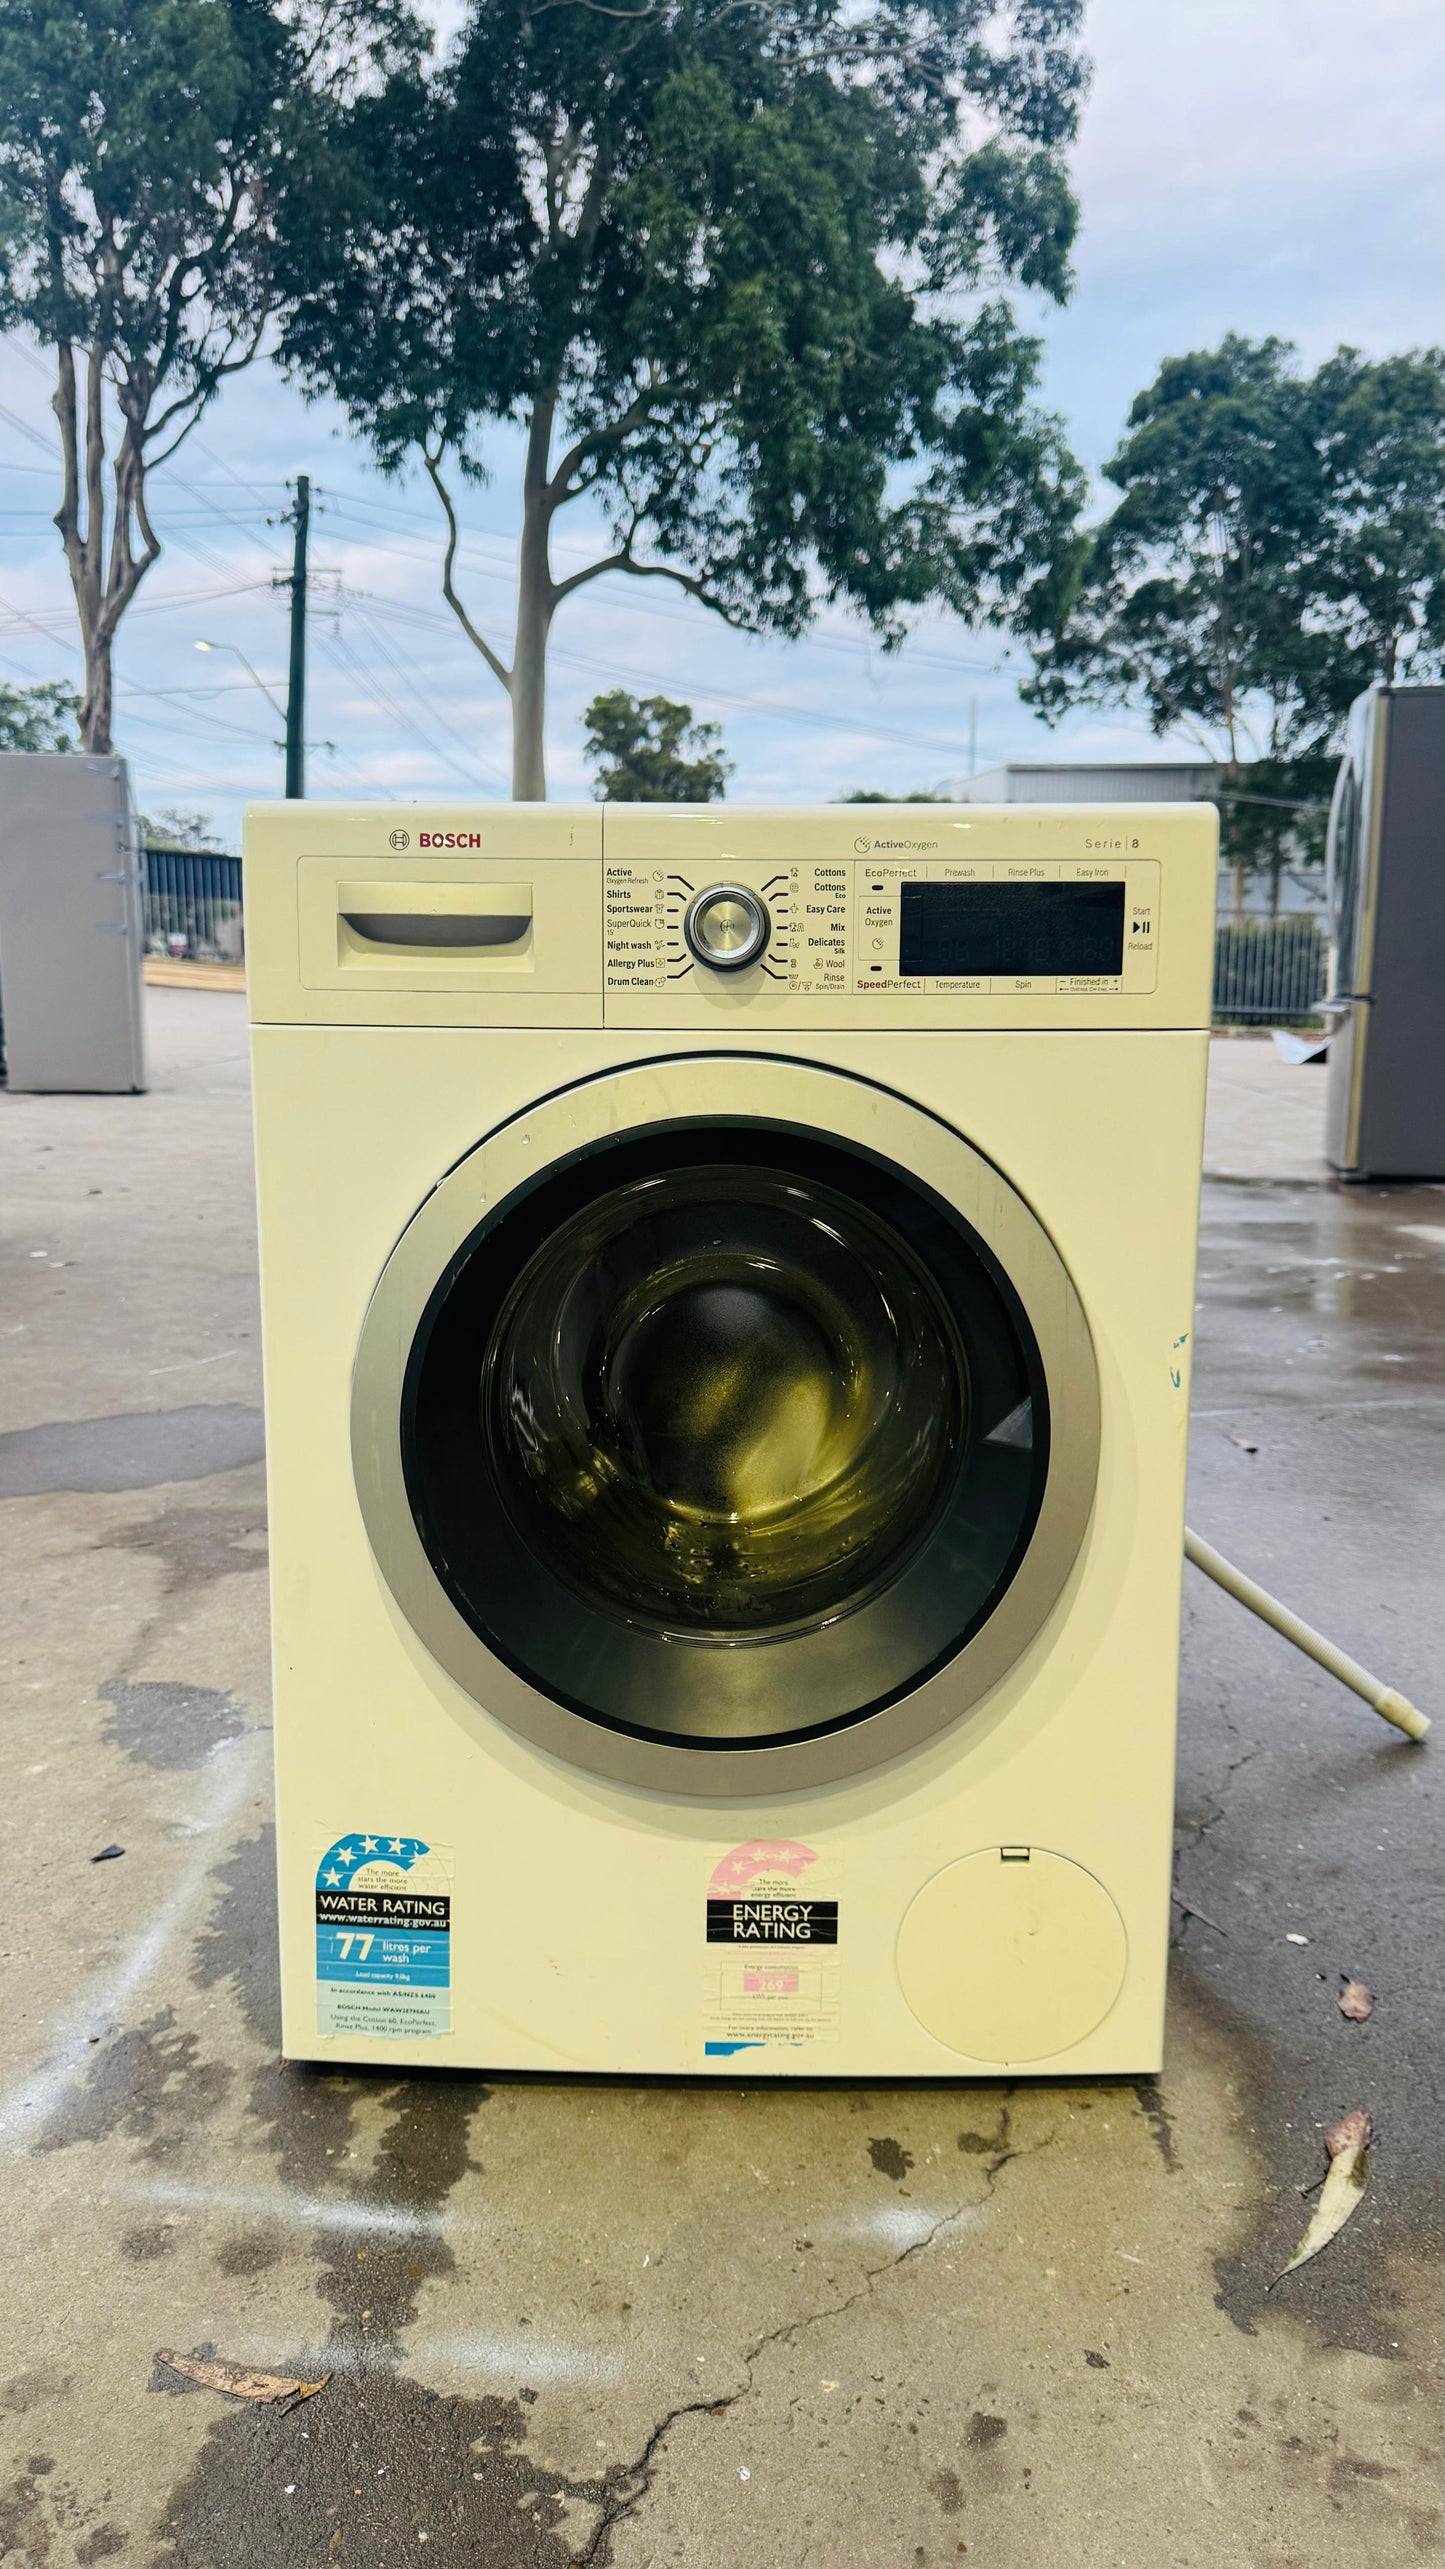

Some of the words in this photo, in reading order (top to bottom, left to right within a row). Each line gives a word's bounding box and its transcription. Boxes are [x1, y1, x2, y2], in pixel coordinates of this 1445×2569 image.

[420, 833, 481, 848] BOSCH
[1086, 839, 1122, 849] Serie
[1132, 839, 1139, 848] 8
[874, 840, 938, 851] ActiveOxygen
[607, 868, 632, 877] Active
[814, 868, 846, 877] Cottons
[865, 868, 917, 878] EcoPerfect
[944, 868, 976, 877] Prewash
[1008, 868, 1029, 877] Rinse
[1030, 868, 1045, 877] Plus
[1076, 868, 1093, 878] Easy
[1094, 868, 1109, 877] Iron
[814, 883, 846, 891] Cottons
[607, 890, 632, 899] Shirts
[607, 905, 653, 914] Sportswear
[806, 905, 825, 915] Easy
[827, 905, 846, 914] Care
[866, 907, 892, 915] Active
[1133, 907, 1151, 916] Start
[607, 920, 652, 929] SuperQuick
[865, 918, 893, 927] Oxygen
[830, 923, 846, 932] Mix
[607, 941, 629, 951] Night
[631, 941, 652, 949] wash
[808, 938, 846, 946] Delicates
[1128, 942, 1153, 951] Reload
[608, 960, 636, 969] Allergy
[638, 960, 655, 968] Plus
[826, 960, 845, 968] Wool
[608, 977, 631, 986] Drum
[632, 977, 654, 986] Clean
[824, 973, 845, 982] Rinse
[1070, 978, 1100, 986] Finished
[1102, 978, 1109, 986] in
[816, 983, 845, 991] Spin/Drain
[857, 980, 921, 991] SpeedPerfect
[935, 981, 981, 990] Temperature
[1016, 981, 1032, 989] Spin
[320, 1895, 378, 1912] WATER
[383, 1899, 445, 1916] RATING
[733, 1904, 813, 1922] ENERGY
[319, 1913, 447, 1928] www.waterrating.gov.au
[733, 1922, 811, 1939] RATING
[336, 1932, 375, 1961] 77
[383, 1941, 410, 1953] litres
[413, 1944, 431, 1955] per
[382, 1953, 410, 1964] wash
[760, 1980, 784, 1991] 269
[331, 2014, 348, 2022] Using
